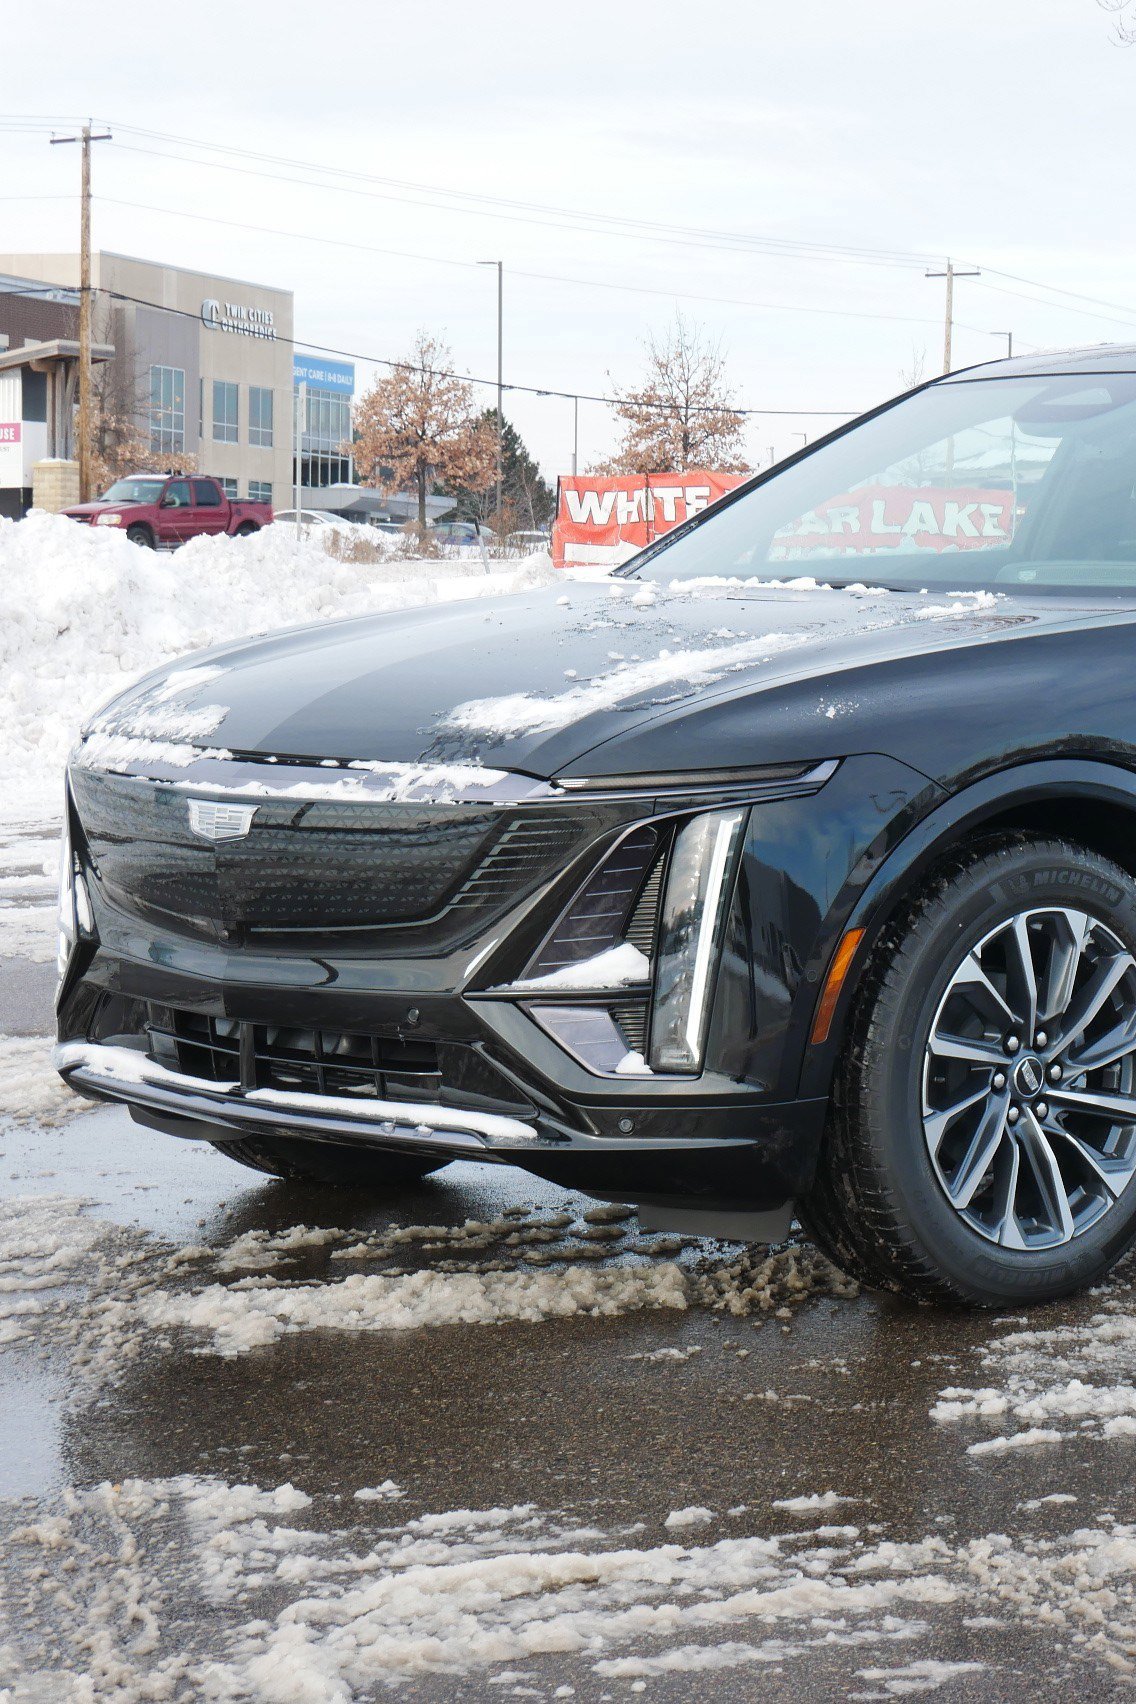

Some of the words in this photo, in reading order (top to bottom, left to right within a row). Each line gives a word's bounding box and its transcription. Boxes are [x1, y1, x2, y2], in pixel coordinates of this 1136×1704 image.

[221, 316, 277, 341] ORTHOPEDICS
[225, 302, 246, 319] TWIN
[248, 307, 274, 326] CITIES
[564, 485, 711, 526] WHITE
[871, 500, 1008, 538] LAKE
[1033, 870, 1120, 903] MICHELIN
